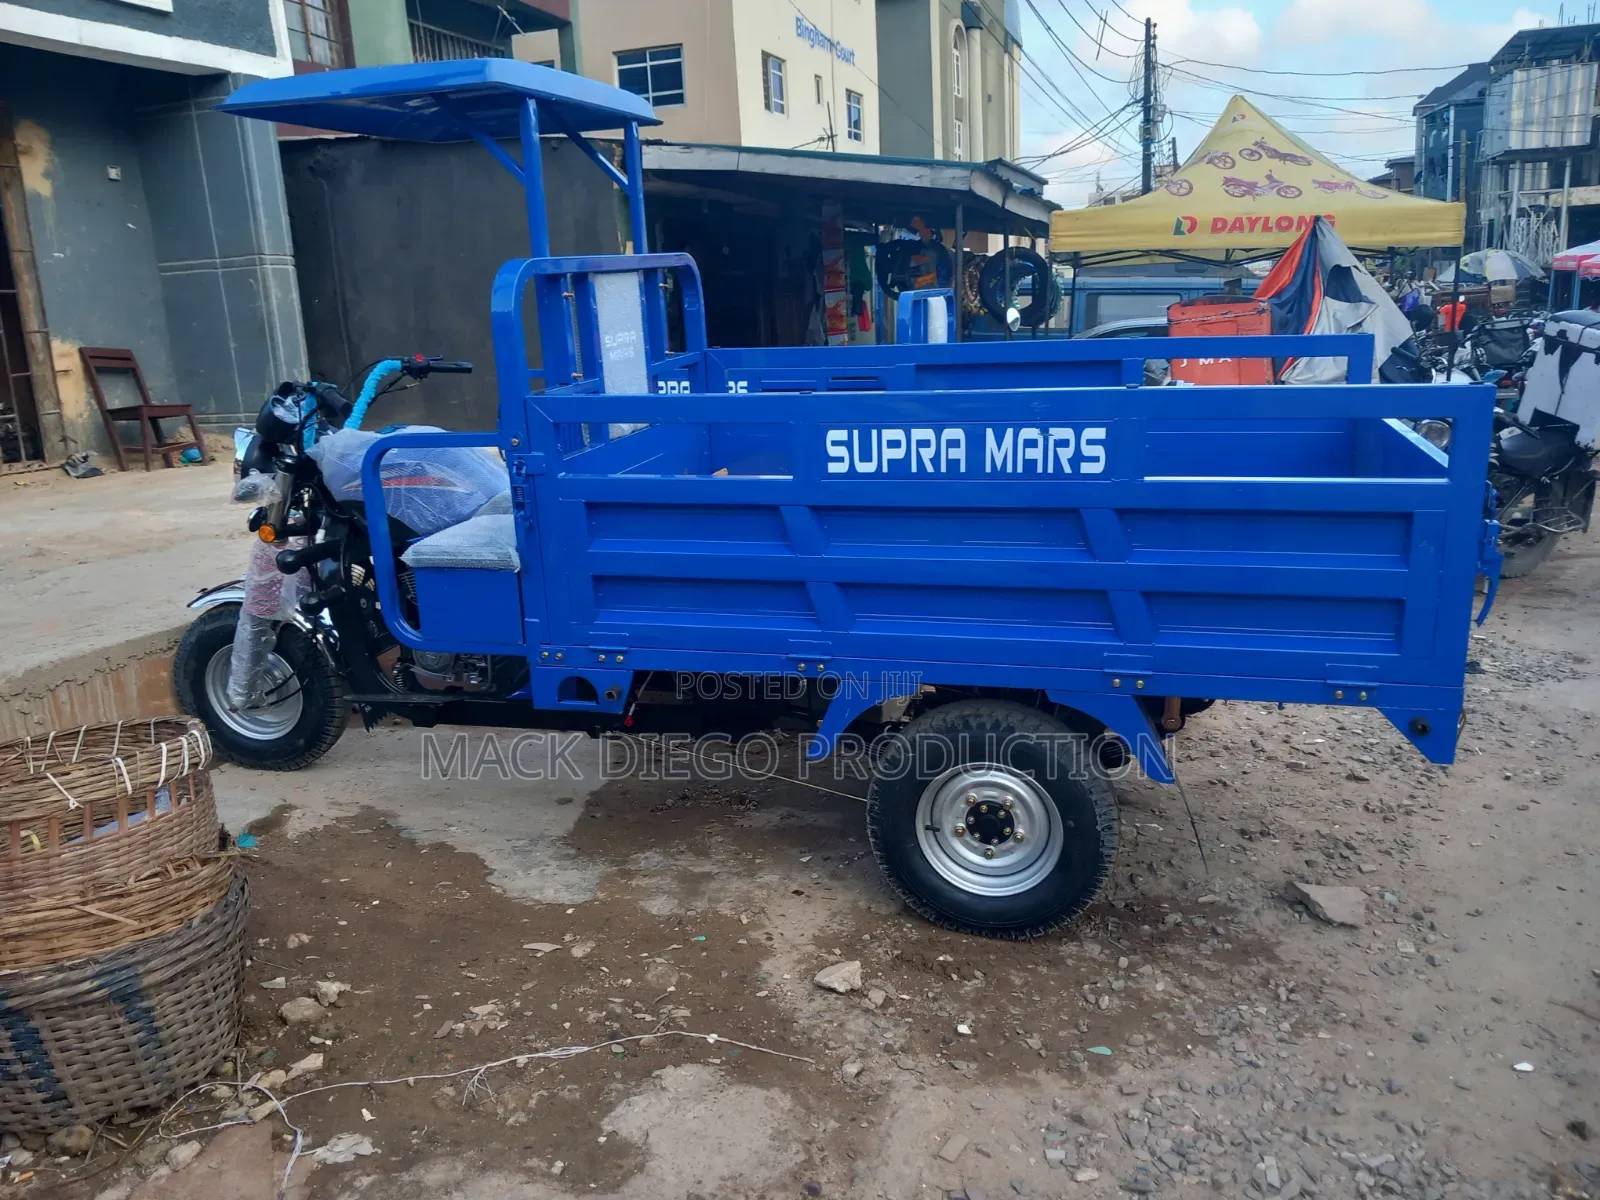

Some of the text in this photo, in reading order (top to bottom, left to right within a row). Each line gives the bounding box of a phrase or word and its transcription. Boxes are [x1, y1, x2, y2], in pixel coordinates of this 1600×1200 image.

[795, 16, 856, 65] Bingham Court
[825, 427, 1107, 474] SUPRA MARS
